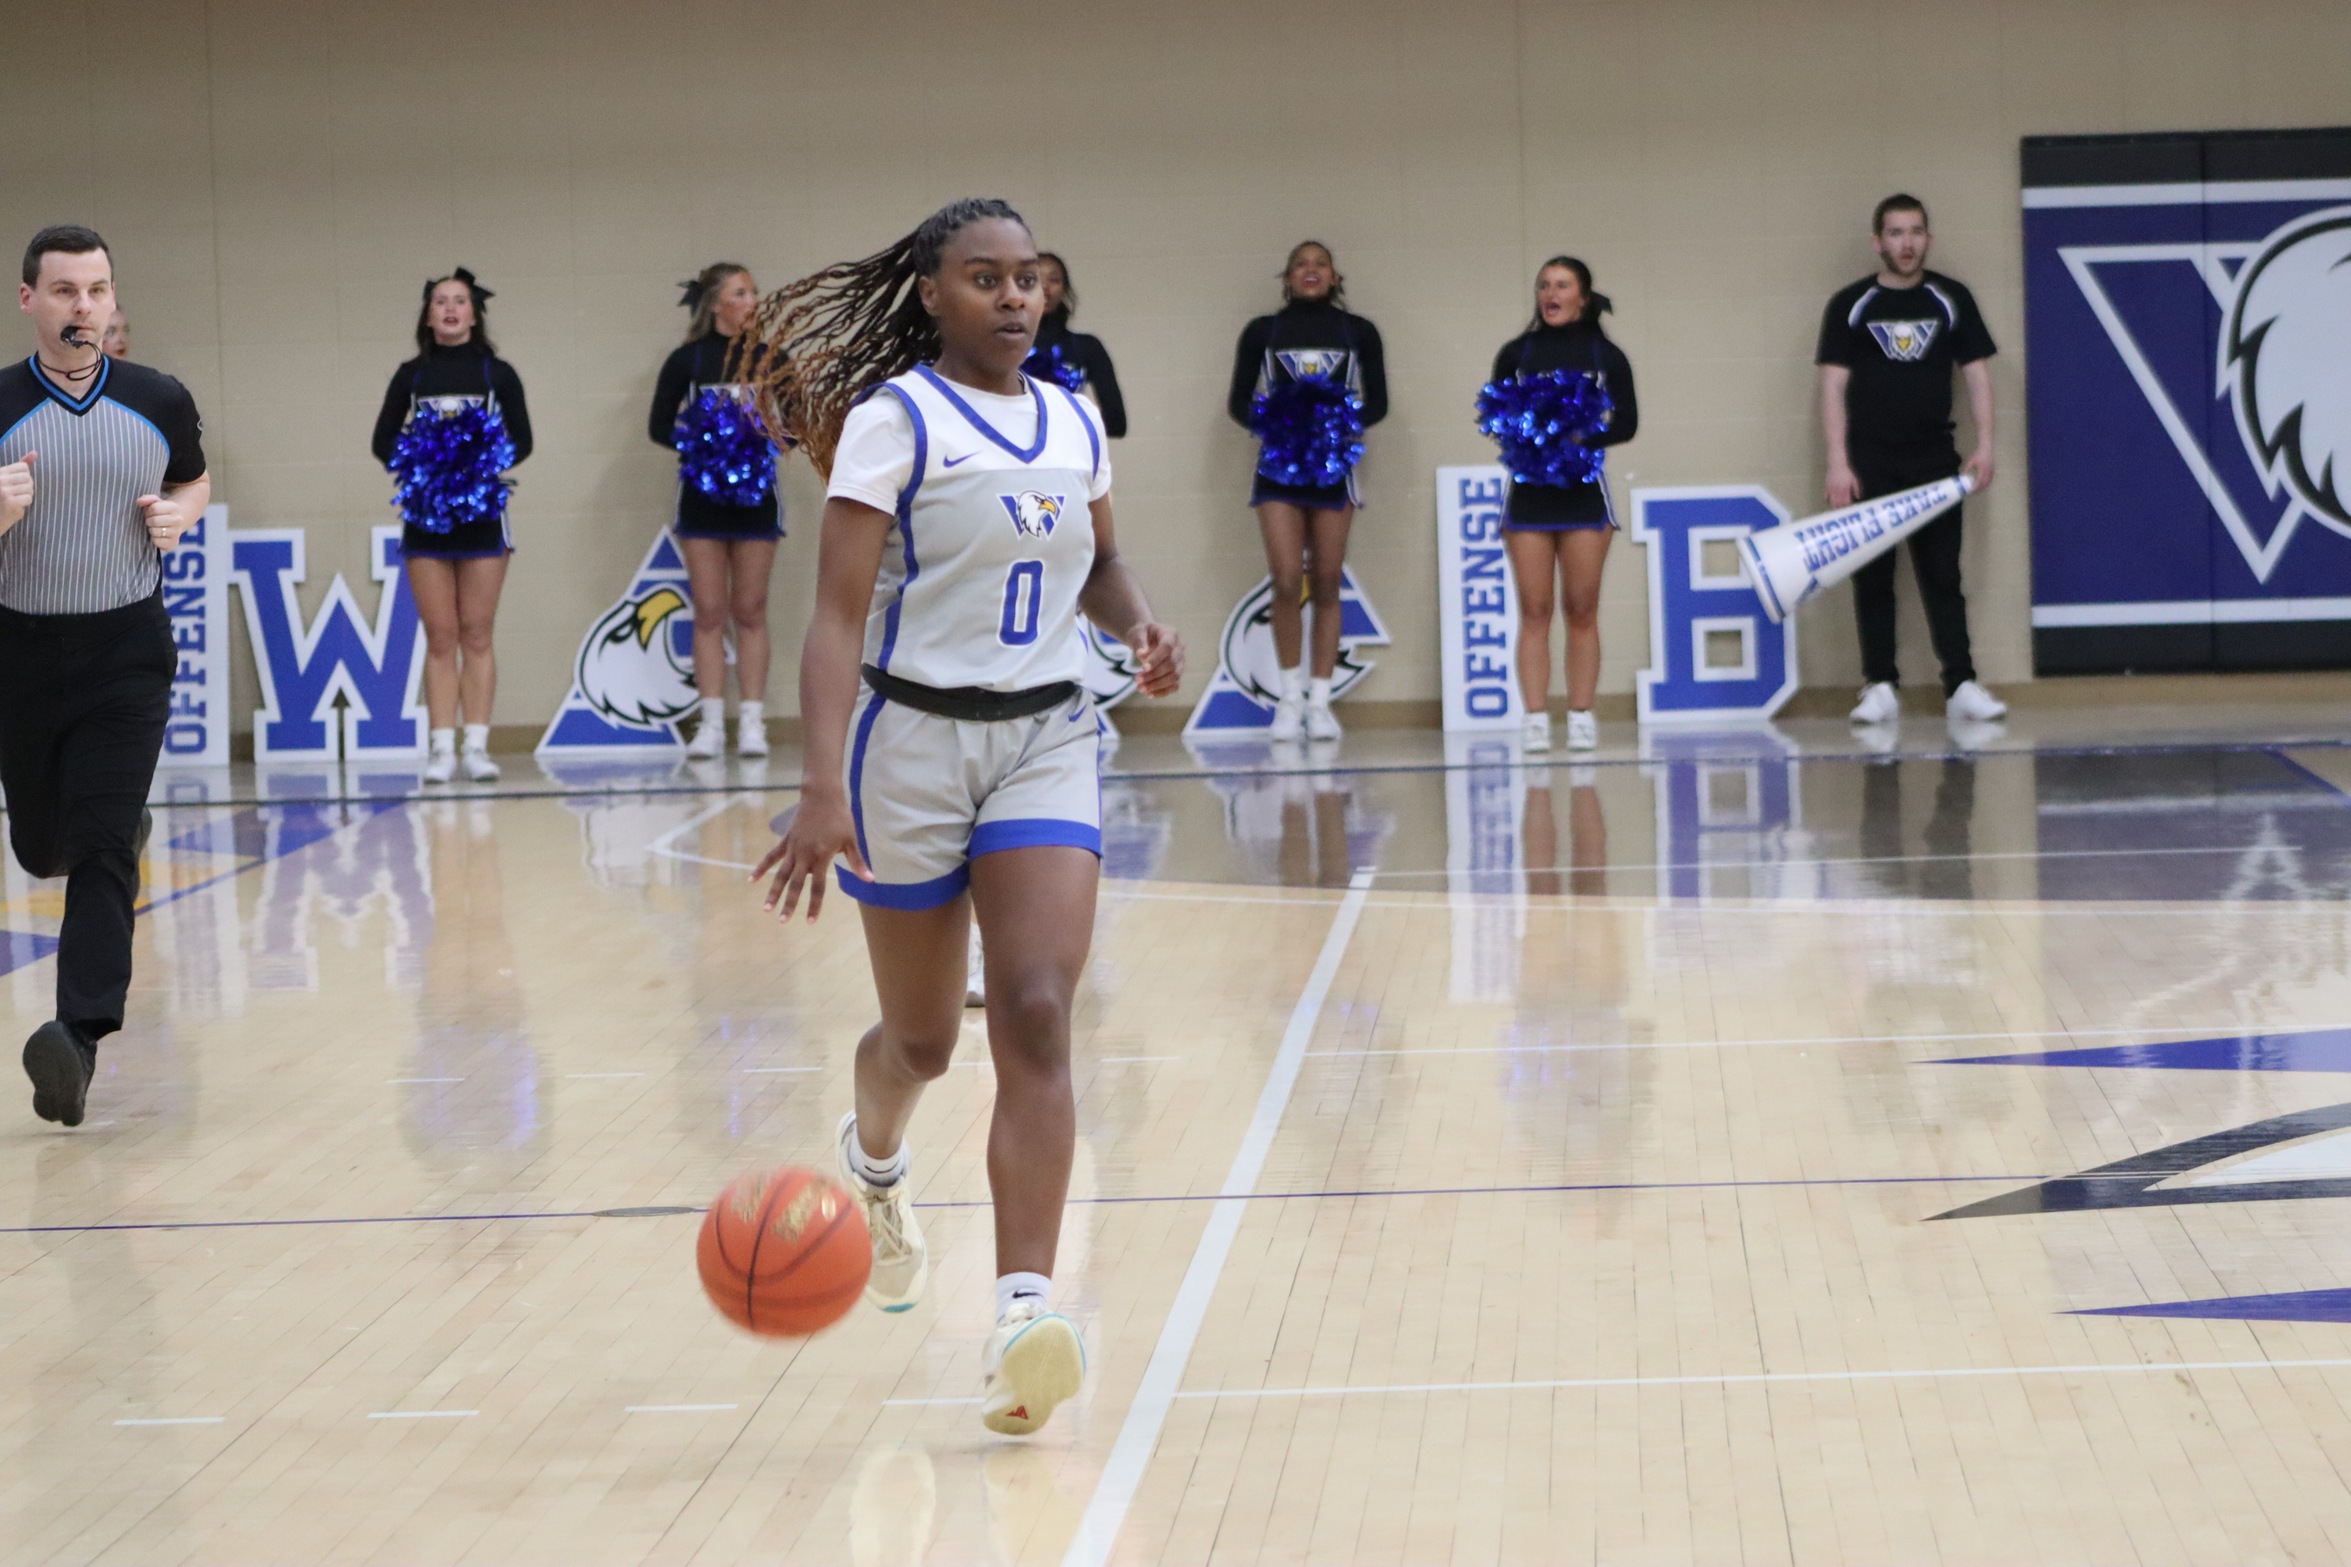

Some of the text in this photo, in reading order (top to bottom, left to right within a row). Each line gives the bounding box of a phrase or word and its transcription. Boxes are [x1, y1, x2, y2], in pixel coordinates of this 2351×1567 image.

[231, 532, 424, 756] W
[1458, 477, 1509, 719] OFFENSE
[1636, 490, 1793, 717] B
[1794, 507, 1884, 573] FLIGHT
